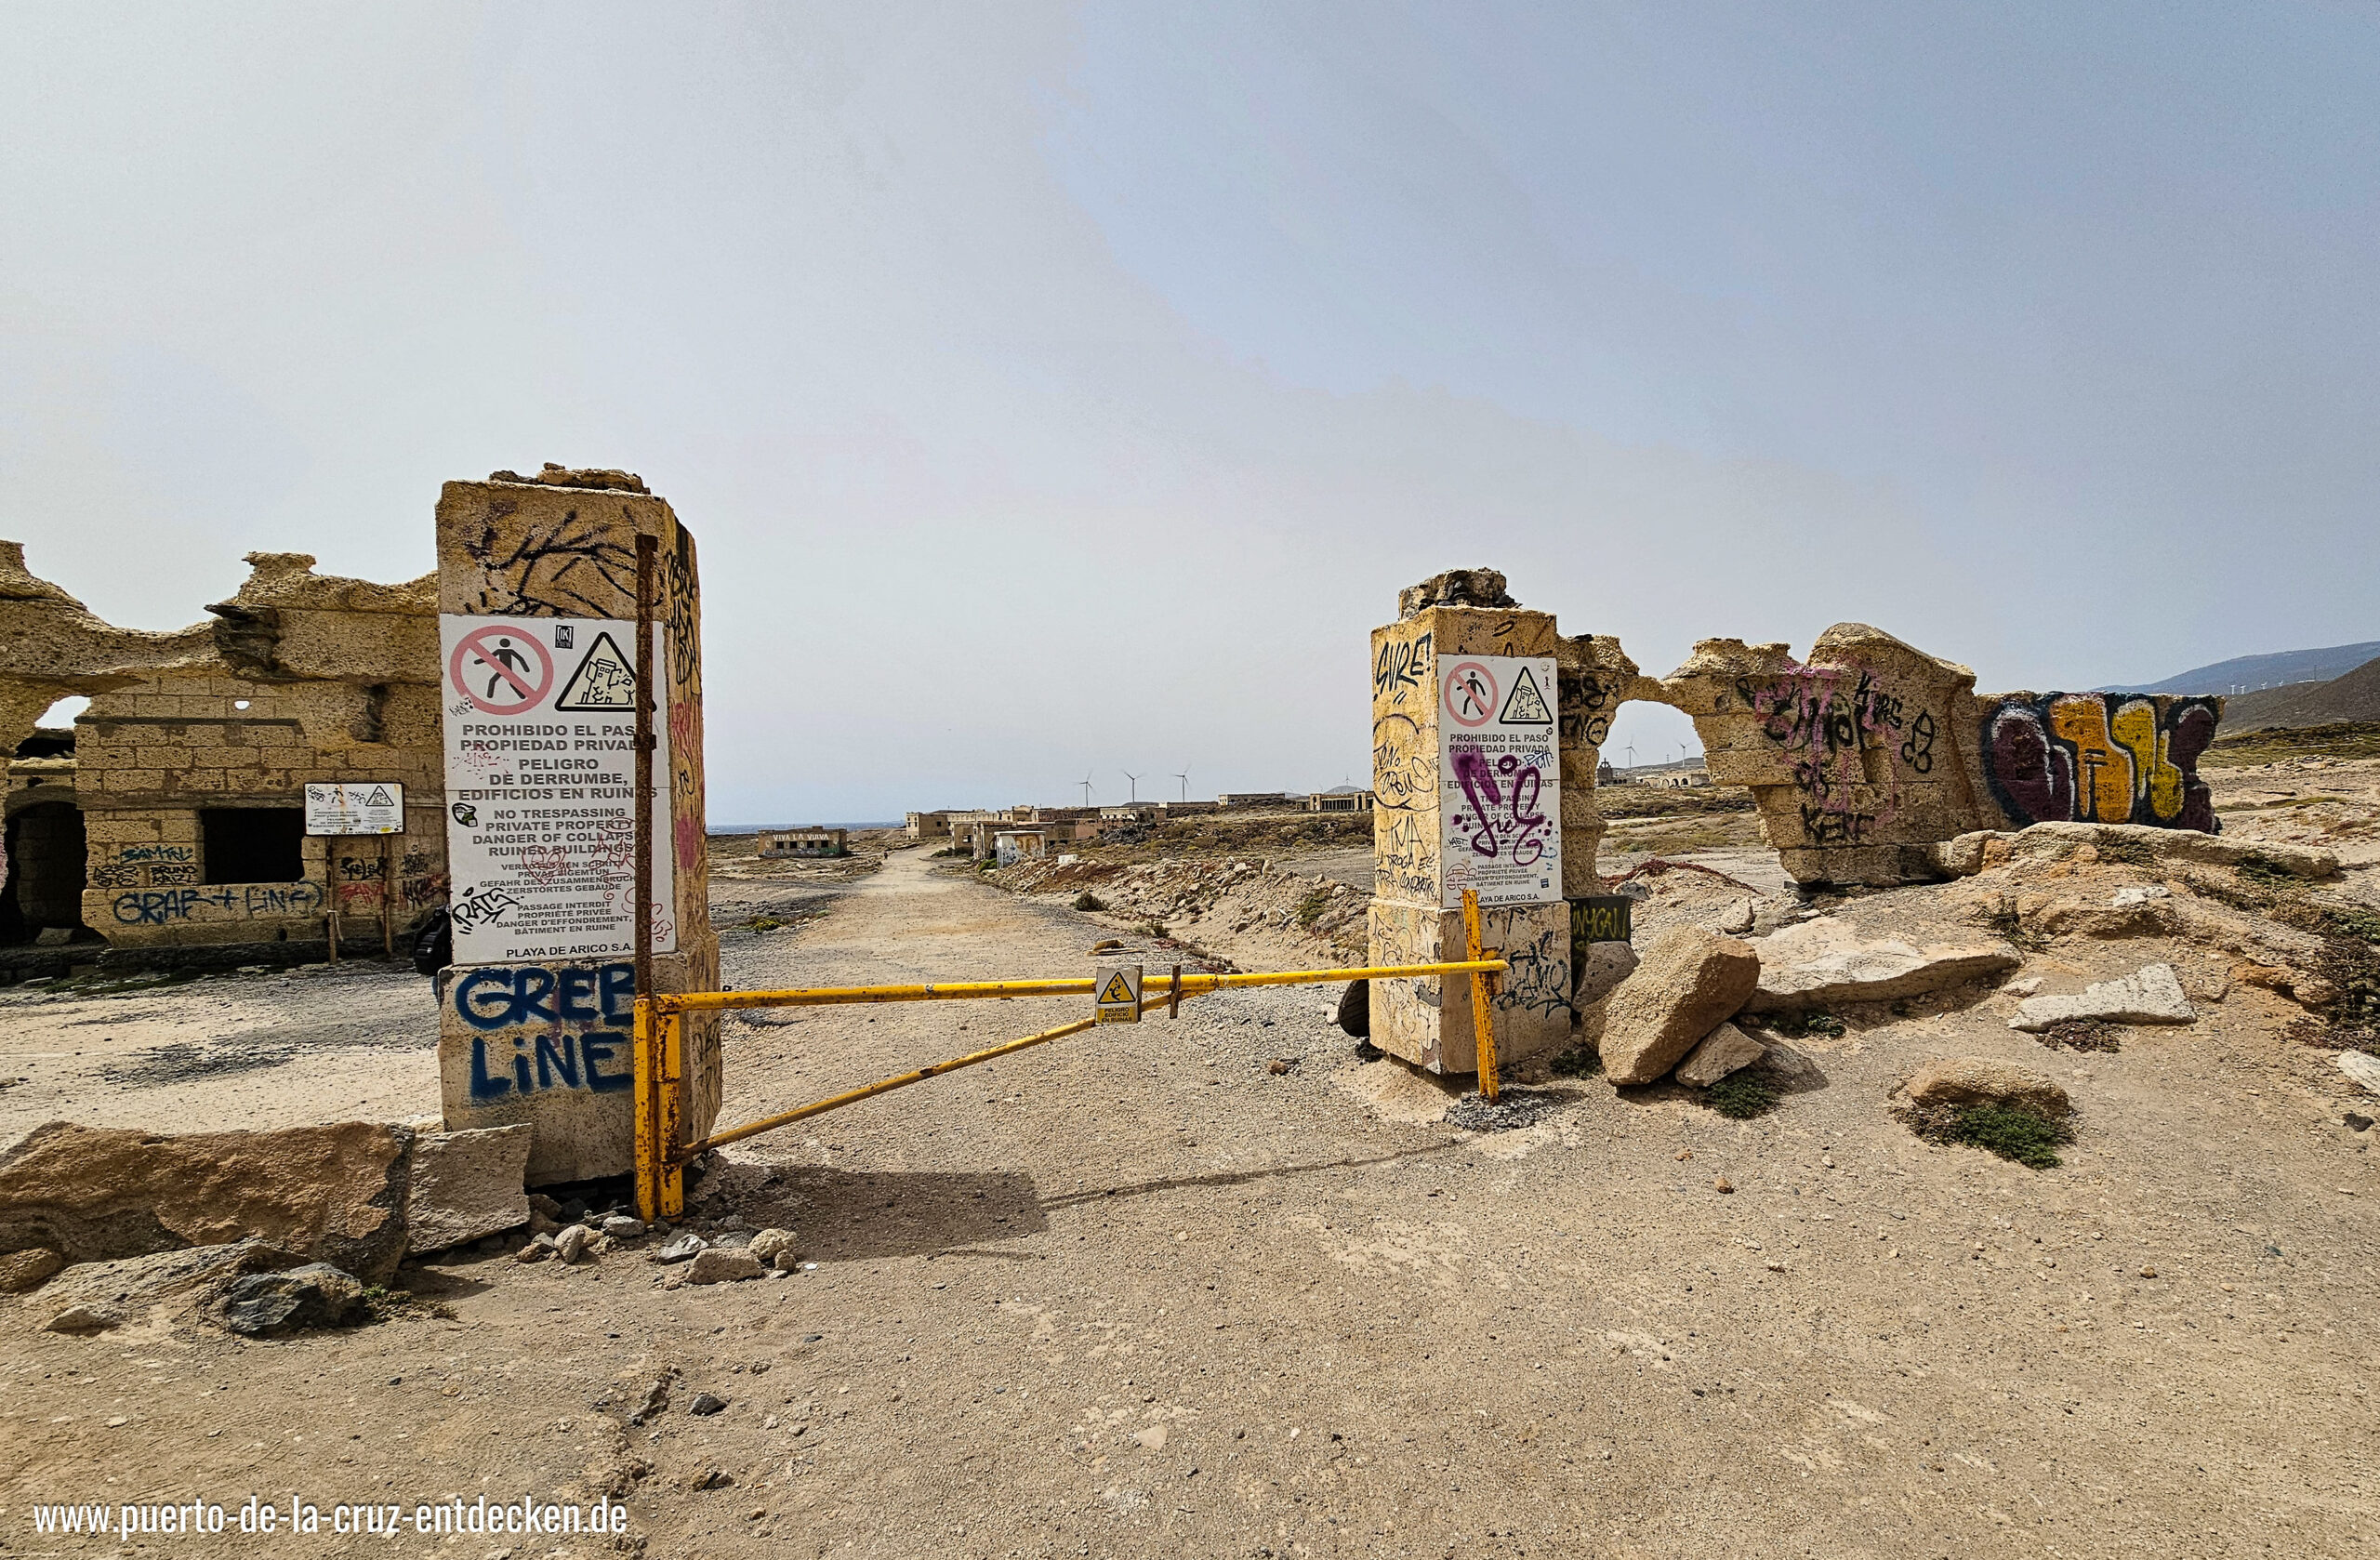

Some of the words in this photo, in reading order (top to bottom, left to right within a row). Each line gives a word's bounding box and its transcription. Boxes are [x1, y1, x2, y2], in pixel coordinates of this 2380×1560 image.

[462, 724, 568, 736] PROHIBIDO
[574, 725, 596, 736] EL
[602, 725, 636, 736] PAS
[1449, 734, 1506, 743] PROHIBIDO
[1509, 734, 1521, 742] EL
[1524, 734, 1549, 742] PASO
[460, 740, 568, 751] PROPIEDAD
[574, 740, 636, 751] PRIVAD
[1448, 745, 1506, 753] PROPIEDAD
[1509, 745, 1550, 753] PRIVADA
[518, 759, 599, 770] PELIGRO
[1479, 759, 1522, 767] PELO
[489, 773, 514, 786] DE
[520, 773, 628, 787] DERRUMBE,
[1501, 780, 1514, 788] EN
[1517, 780, 1554, 788] UIAS
[458, 788, 553, 801] EDIFICIOS
[560, 788, 584, 800] EN
[590, 787, 658, 800] RUINS
[1461, 804, 1496, 813] PRATE
[1498, 803, 1540, 812] PROERY
[494, 810, 516, 820] NO
[521, 808, 626, 819] TRESPASSING
[485, 821, 550, 832] PRIVATE
[558, 820, 632, 831] PROPERTY
[472, 834, 536, 845] DANGER
[541, 832, 562, 843] OF
[566, 831, 635, 841] COLLAPS
[488, 845, 547, 856] RUINED
[551, 843, 634, 854] BUILDINGS
[480, 879, 521, 888] GEFAHR
[518, 904, 562, 912] PASSAGE
[565, 901, 612, 910] INTERDIT
[496, 919, 538, 929] DANGER
[541, 915, 632, 927] D'EFFONDREMENT,
[569, 925, 583, 933] EN
[586, 923, 615, 932] RUINE
[507, 947, 546, 958] PLAYA
[549, 945, 566, 957] DE
[569, 944, 608, 955] ARICO
[611, 942, 634, 952] S.A.
